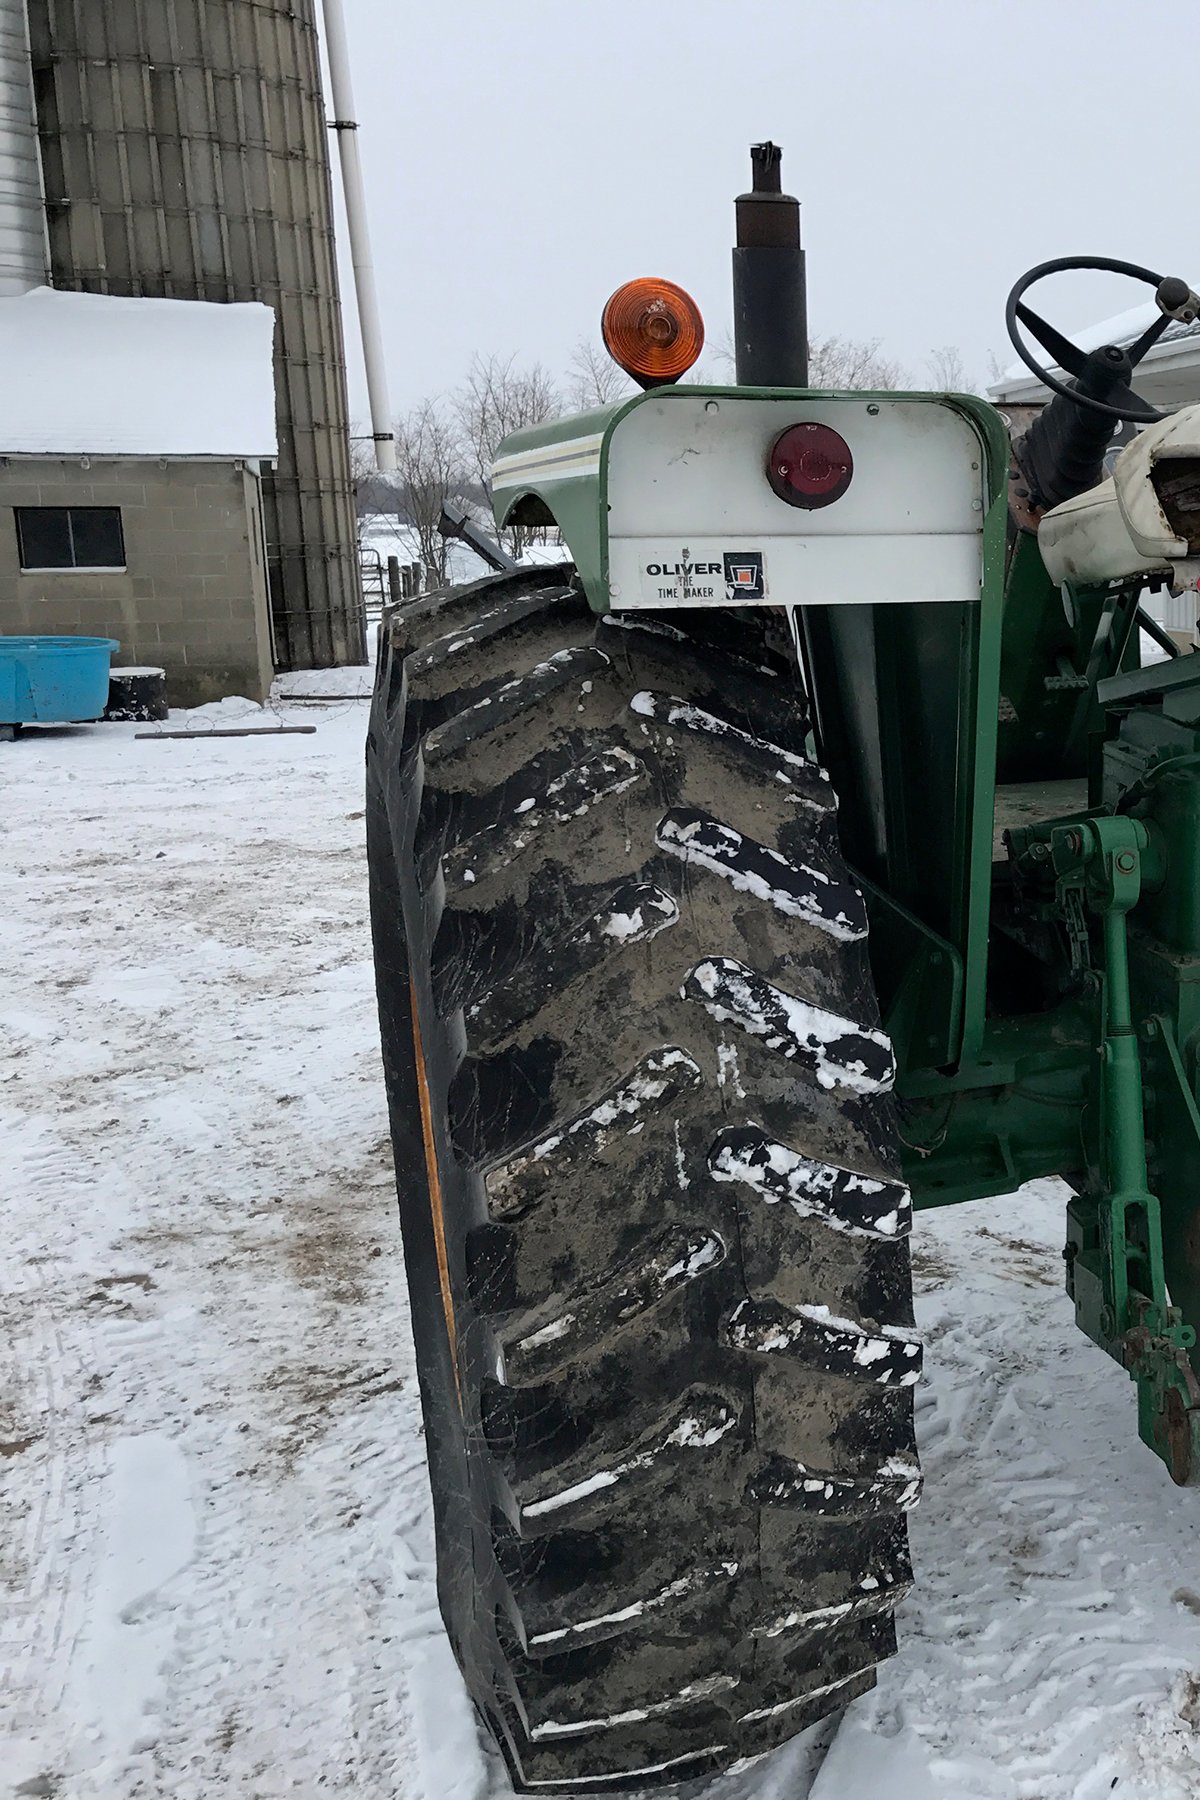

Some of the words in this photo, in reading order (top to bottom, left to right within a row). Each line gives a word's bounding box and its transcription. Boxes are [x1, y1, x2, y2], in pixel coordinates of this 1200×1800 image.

[646, 563, 722, 576] OLIVER
[658, 588, 679, 599] TIME
[684, 587, 714, 598] MAKER
